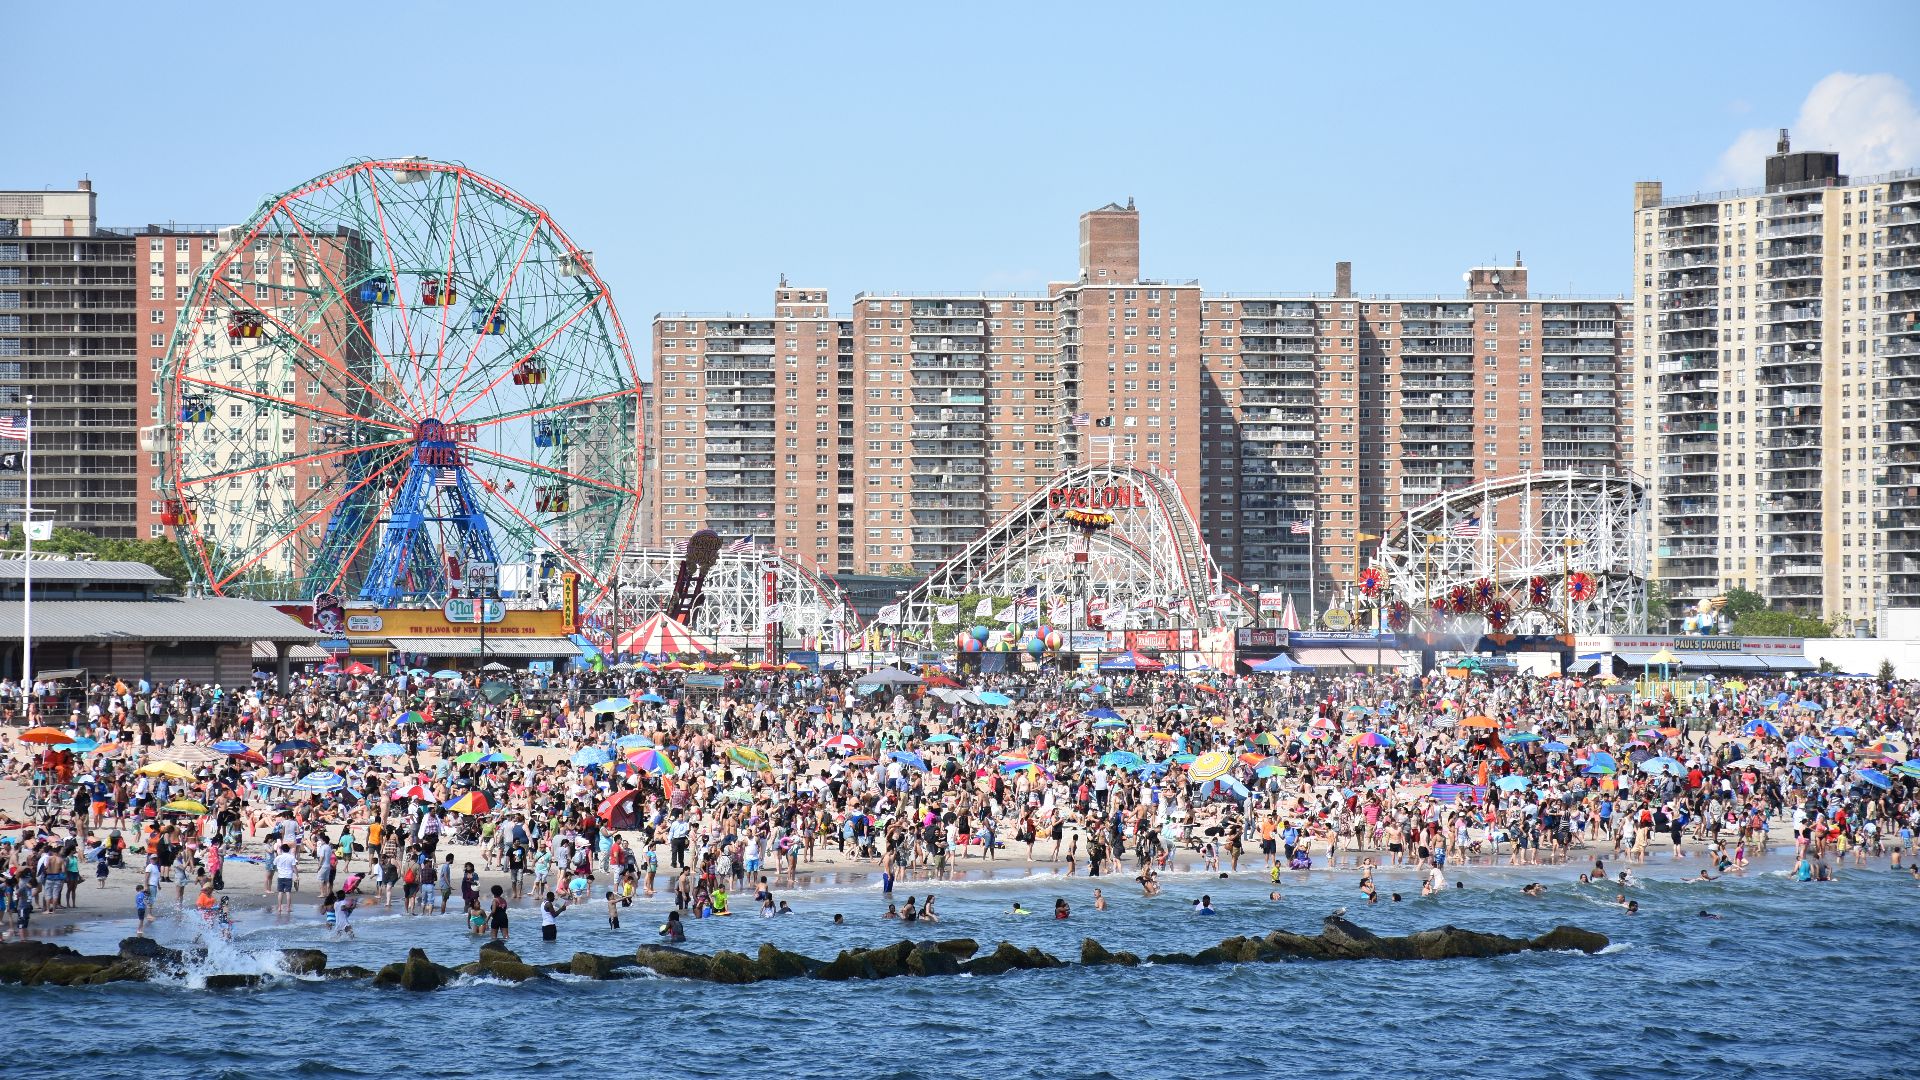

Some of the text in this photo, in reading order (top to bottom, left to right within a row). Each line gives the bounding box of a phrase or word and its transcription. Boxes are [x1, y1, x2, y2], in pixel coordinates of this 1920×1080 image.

[412, 424, 477, 442] WONDER
[419, 447, 473, 466] WHEEL
[1049, 485, 1146, 509] CYCLONE
[1675, 640, 1699, 649] PAUL'S
[1702, 640, 1740, 650] DAUGHTER
